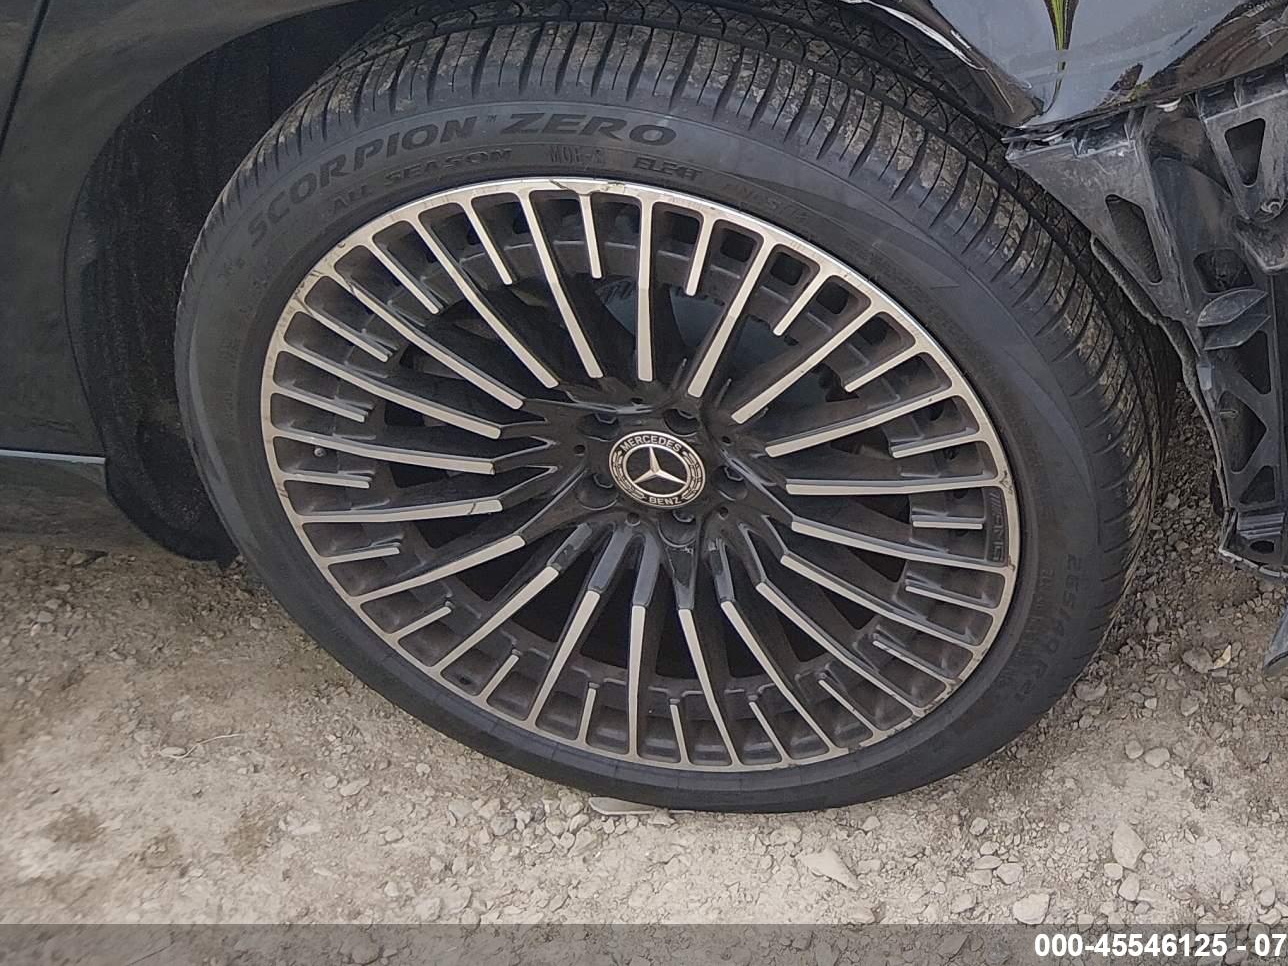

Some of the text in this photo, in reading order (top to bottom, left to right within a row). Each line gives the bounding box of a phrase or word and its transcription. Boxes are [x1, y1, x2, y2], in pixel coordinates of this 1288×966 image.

[384, 148, 512, 182] SEASON
[247, 114, 478, 247] SCORPION
[501, 112, 677, 146] ZERO
[620, 435, 682, 452] MERCEDES
[649, 497, 682, 505] BENZ
